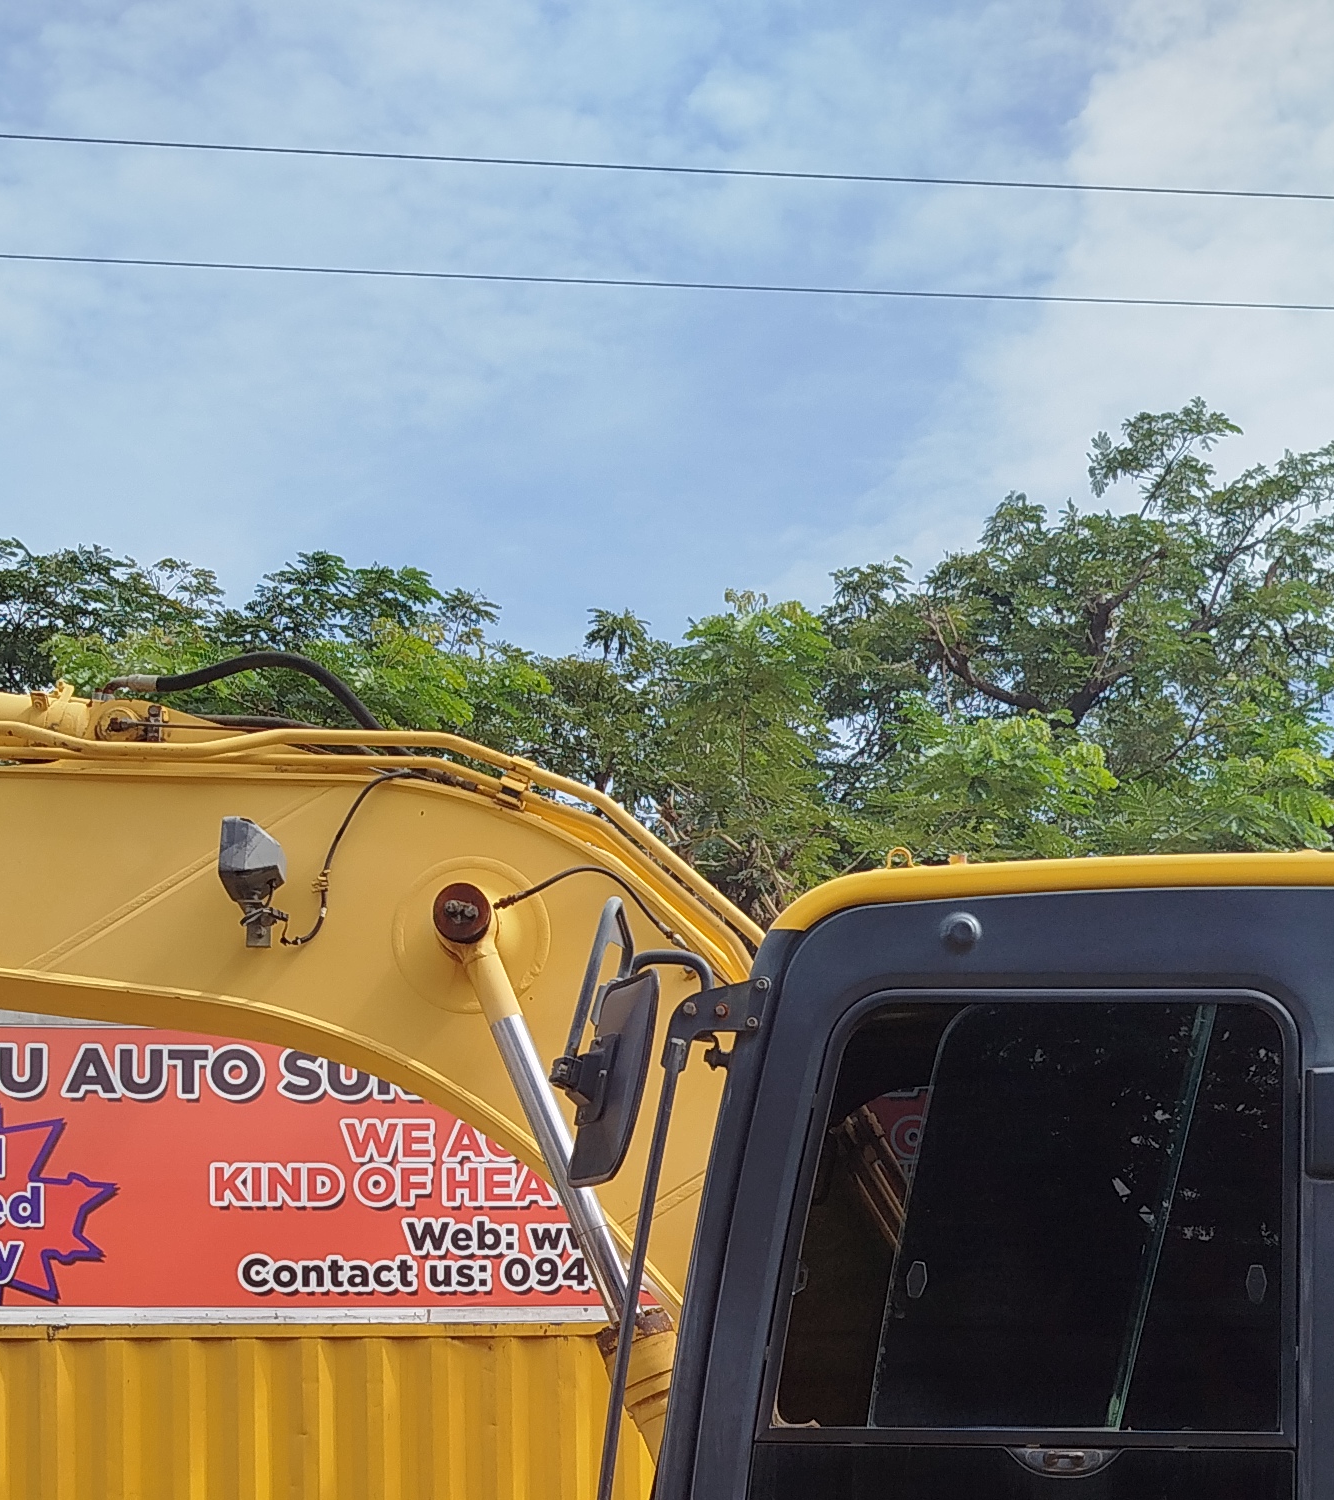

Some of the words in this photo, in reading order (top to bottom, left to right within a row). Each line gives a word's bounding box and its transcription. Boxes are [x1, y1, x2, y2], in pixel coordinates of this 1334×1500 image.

[62, 1044, 264, 1099] AUTO
[340, 1119, 435, 1162] WE
[210, 1162, 345, 1207] KIND
[353, 1162, 434, 1207] OF
[402, 1217, 519, 1255] Web:
[238, 1253, 417, 1293] Contact
[424, 1257, 492, 1292] us:
